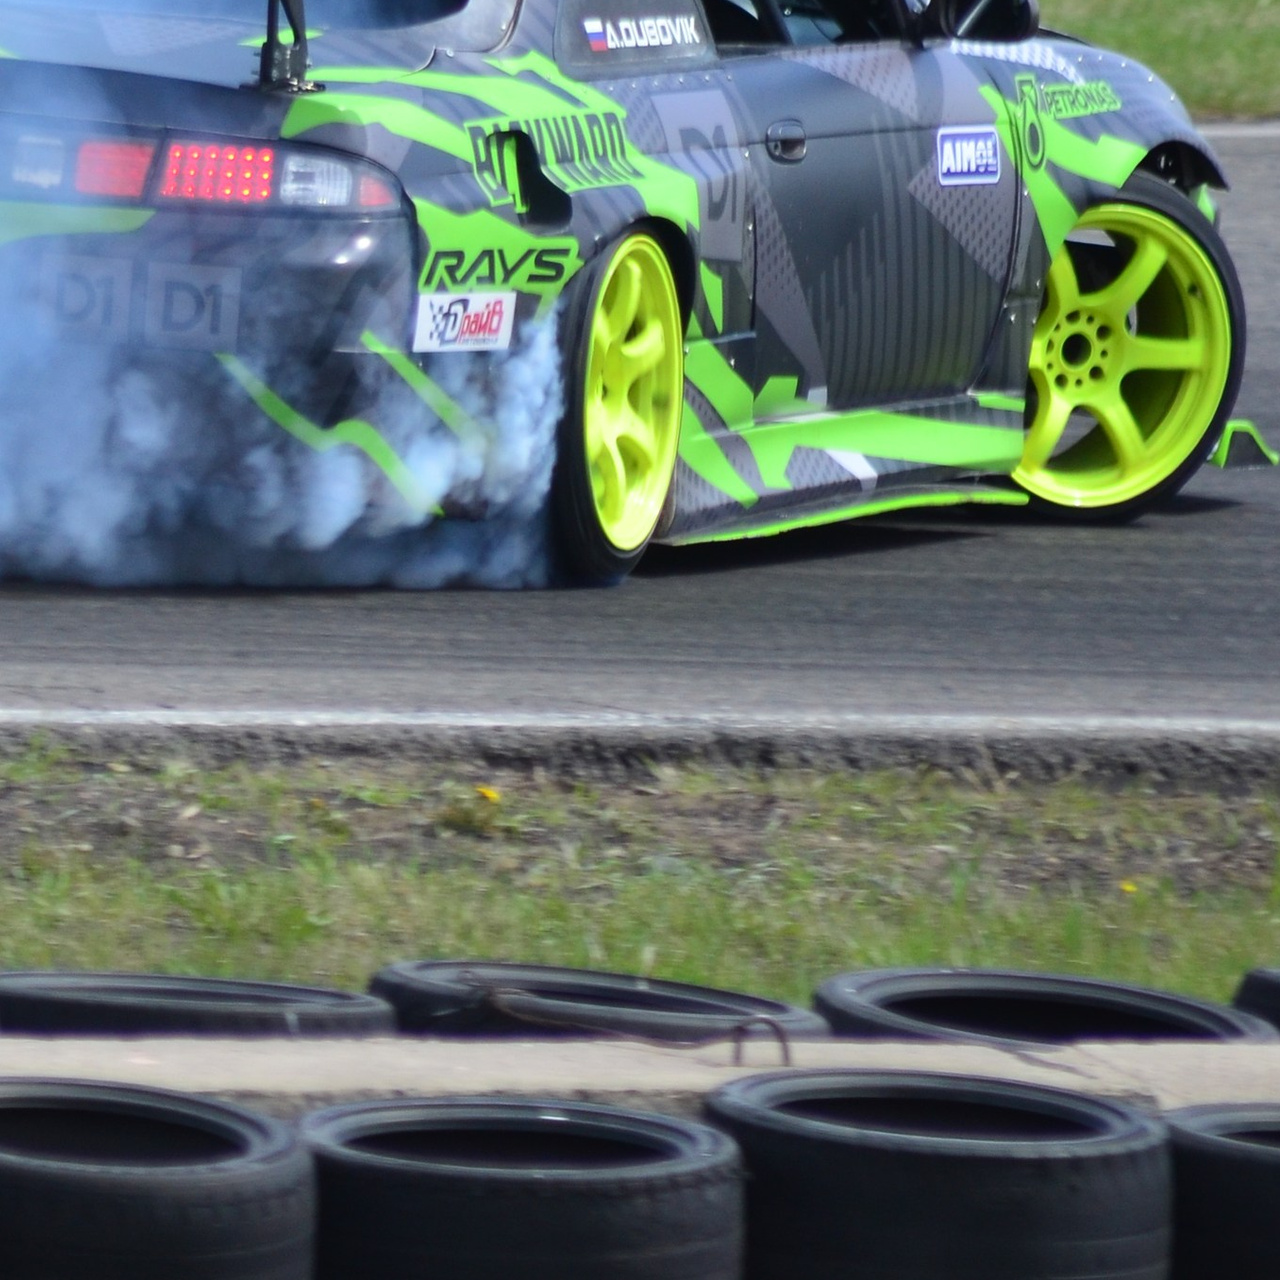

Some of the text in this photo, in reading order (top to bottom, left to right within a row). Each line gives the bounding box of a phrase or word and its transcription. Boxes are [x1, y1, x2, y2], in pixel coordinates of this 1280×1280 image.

[606, 17, 701, 49] A.DUBOVIK
[1045, 85, 1119, 115] PETRONAS
[942, 140, 997, 173] AIMOL
[424, 248, 571, 285] RAYS
[162, 280, 221, 335] D1
